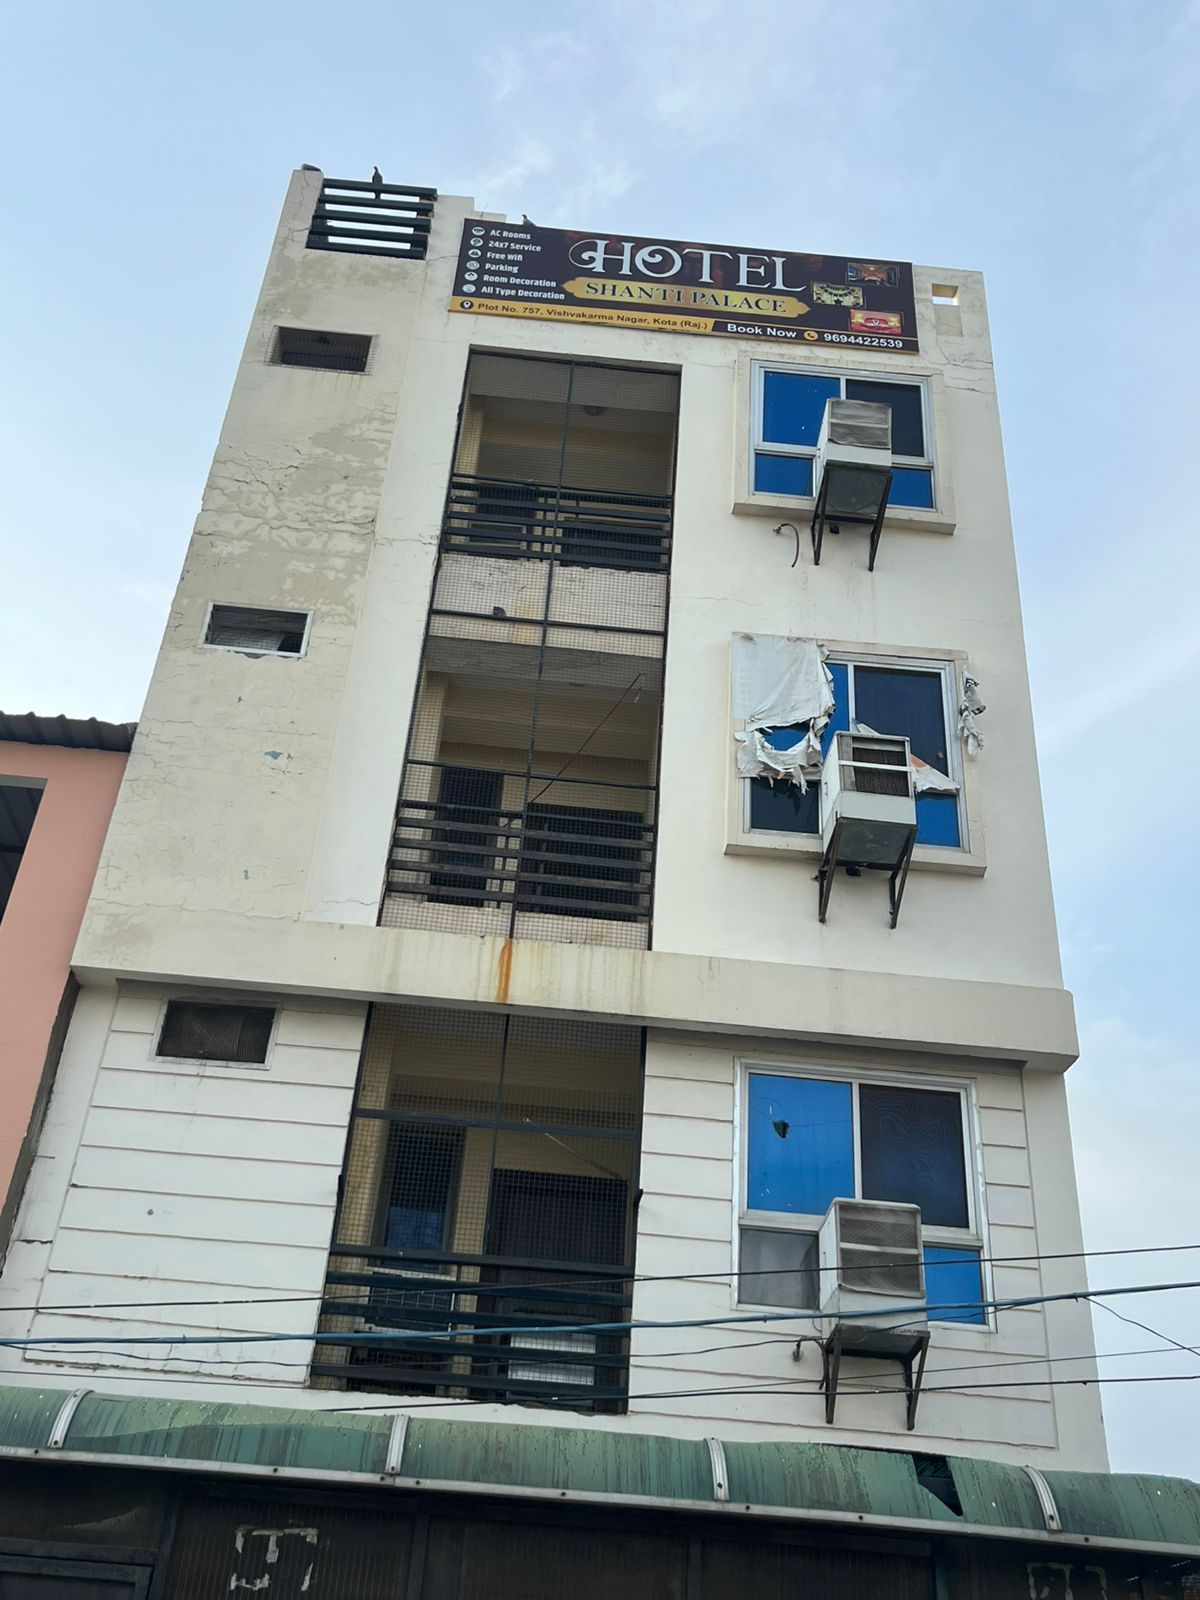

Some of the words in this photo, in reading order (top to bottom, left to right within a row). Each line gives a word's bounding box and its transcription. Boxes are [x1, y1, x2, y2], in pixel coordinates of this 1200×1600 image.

[490, 229, 502, 237] AC
[502, 230, 531, 240] Rooms
[488, 240, 508, 250] 24x7
[510, 242, 542, 252] Service
[486, 252, 506, 260] Free
[484, 263, 519, 274] Parking
[568, 239, 807, 292] HOTEL
[484, 275, 508, 284] Room
[510, 277, 557, 288] Decoration
[481, 286, 493, 294] All
[494, 288, 516, 296] Type
[518, 290, 565, 300] Decoration
[586, 282, 684, 303] SHANTI
[692, 291, 787, 313] PALACE
[478, 303, 499, 312] Plot
[502, 304, 520, 314] No.
[546, 309, 614, 321] Vishvakarma
[617, 315, 650, 326] Nagar,
[653, 318, 678, 327] Kota
[680, 320, 708, 330] (Raj.)
[727, 323, 763, 336] Book
[766, 327, 797, 340] Now
[824, 333, 904, 348] 9694422539
